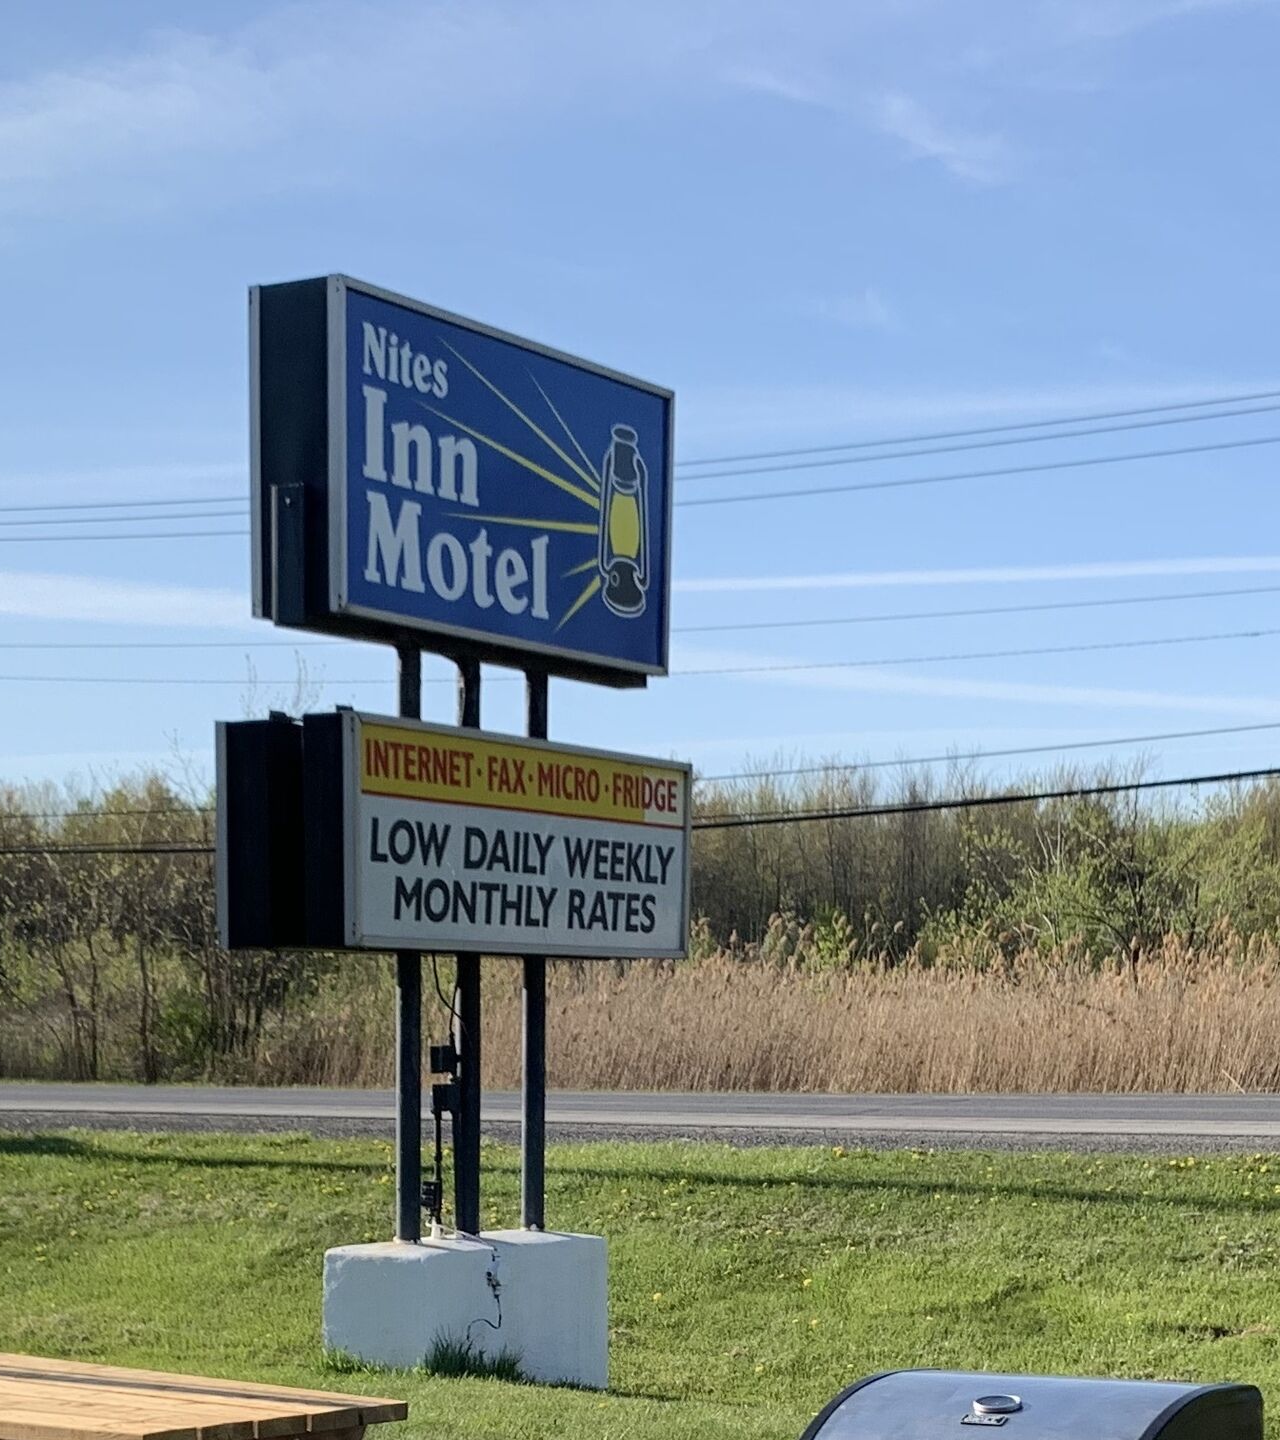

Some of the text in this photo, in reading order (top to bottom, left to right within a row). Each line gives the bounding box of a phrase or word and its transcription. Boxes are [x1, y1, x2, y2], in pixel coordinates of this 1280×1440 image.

[363, 321, 448, 399] Nites
[362, 386, 479, 507] Inn
[364, 491, 549, 619] Motel
[365, 738, 677, 813] INTERNET FAX MICRO FRIDGE
[370, 817, 675, 885] LOW DAILY WEEKLY
[394, 876, 656, 934] MONTHLY RATES
